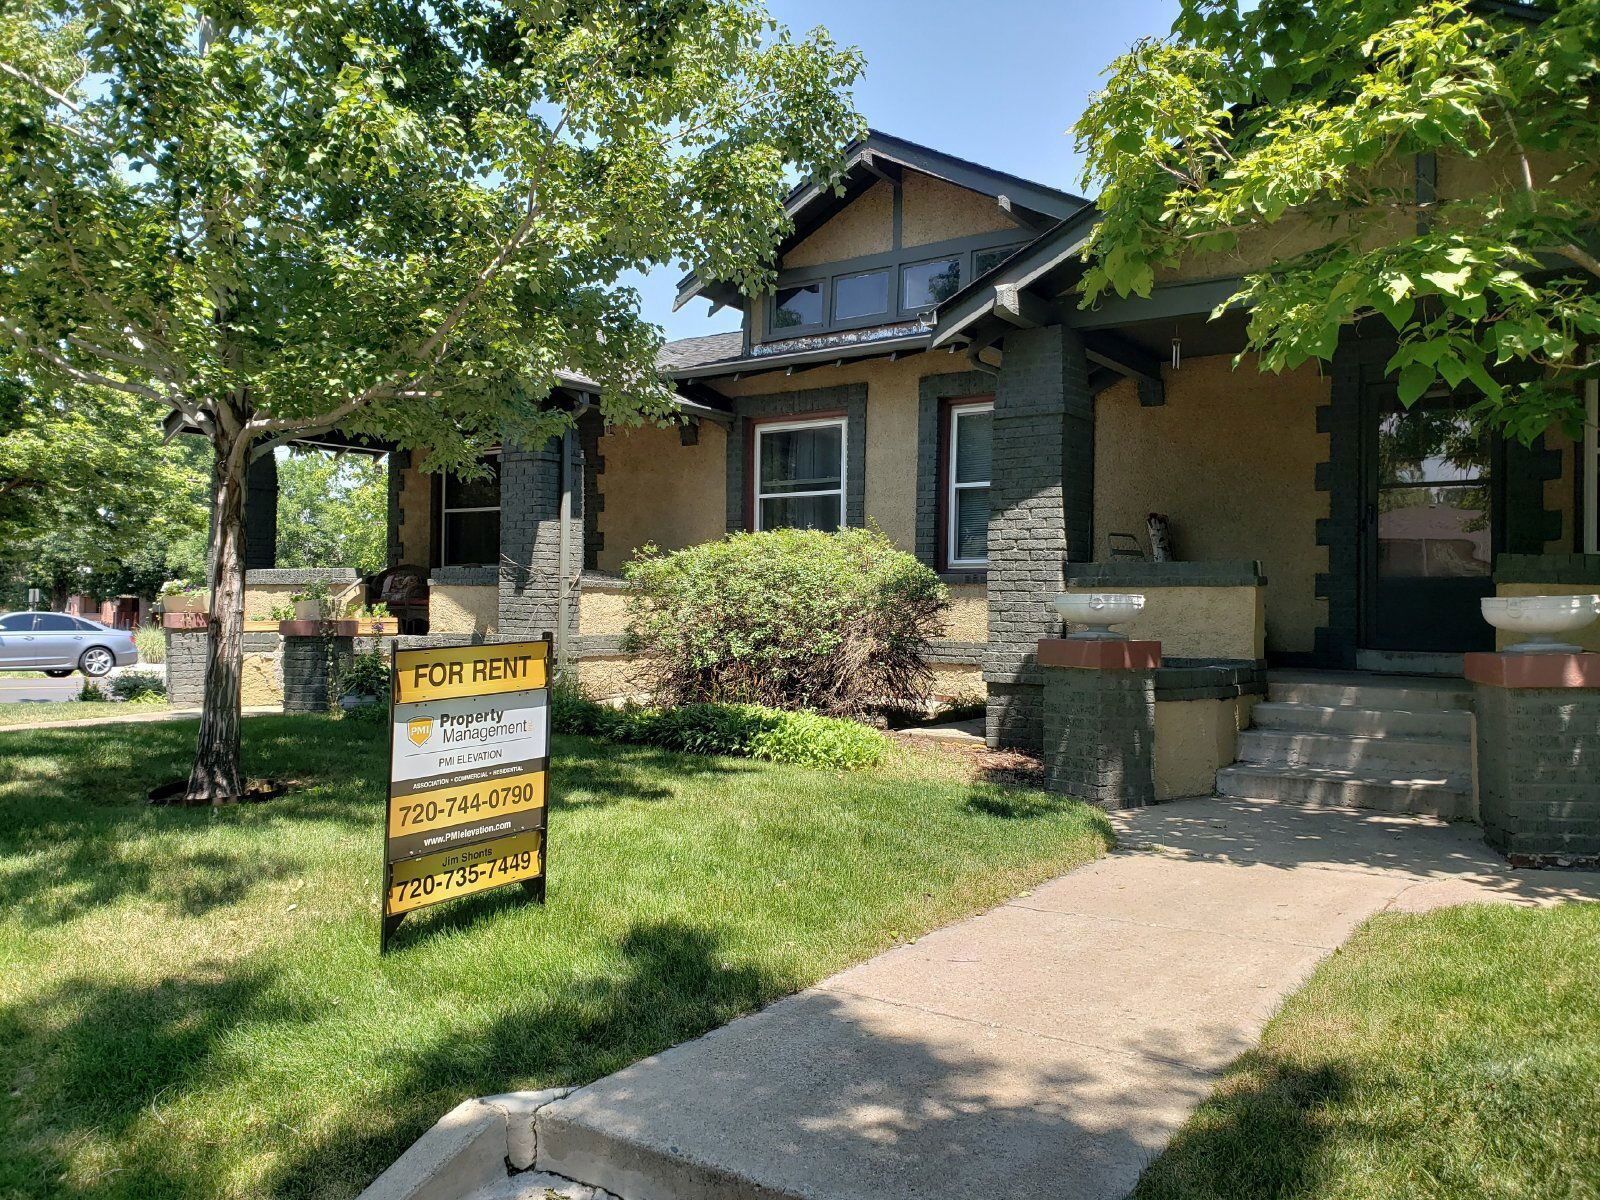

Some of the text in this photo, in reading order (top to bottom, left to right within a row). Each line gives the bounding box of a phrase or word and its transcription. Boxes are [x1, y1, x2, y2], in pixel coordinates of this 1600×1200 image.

[414, 655, 532, 688] FOR RENT
[411, 725, 431, 736] PMI
[440, 709, 504, 728] Property
[443, 720, 527, 743] Management
[438, 749, 503, 767] PMI ELEVATION
[413, 765, 524, 790] ASSOCIATION COMMERCIAL RESIDENTIAL
[399, 783, 534, 827] 720-744-0790
[423, 820, 512, 847] www.PMIelevation.com
[442, 848, 493, 867] Jim Shonts
[396, 850, 531, 902] 720-735-7449
